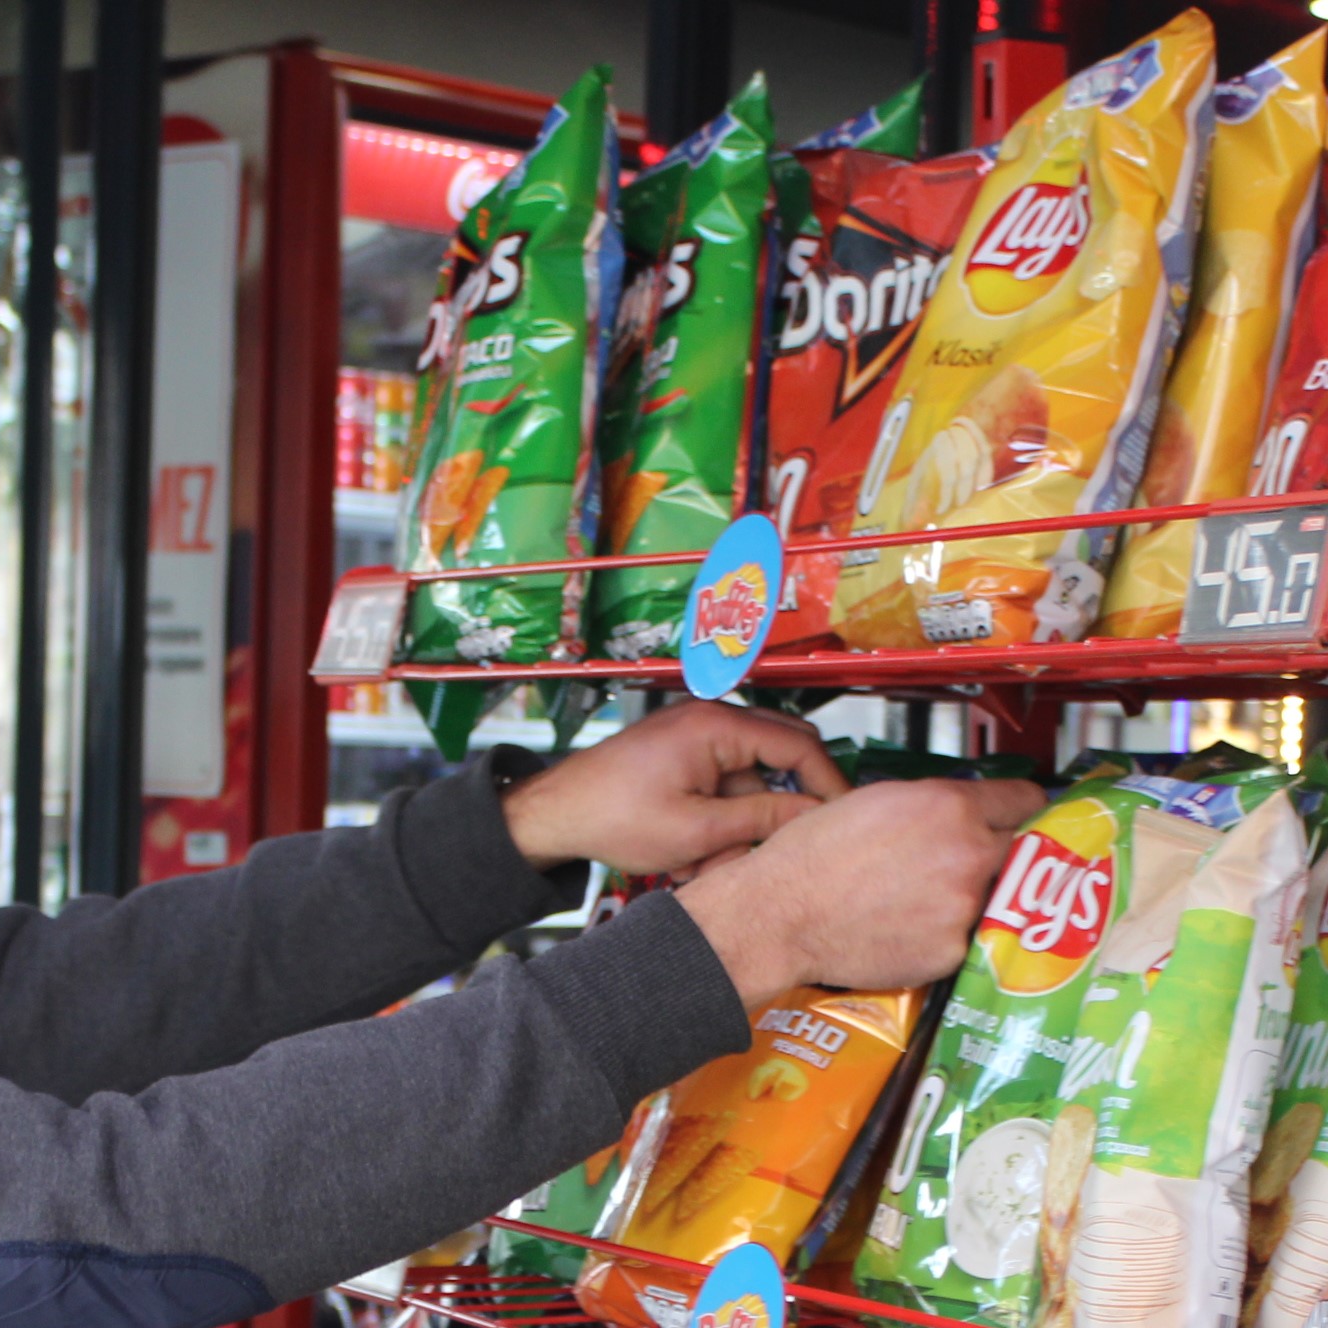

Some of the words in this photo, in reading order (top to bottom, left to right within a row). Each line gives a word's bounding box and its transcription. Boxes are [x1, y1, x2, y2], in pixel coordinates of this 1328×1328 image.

[689, 576, 769, 649] Ruffles
[1194, 520, 1321, 628] 45.0
[982, 833, 1111, 952] Lay's
